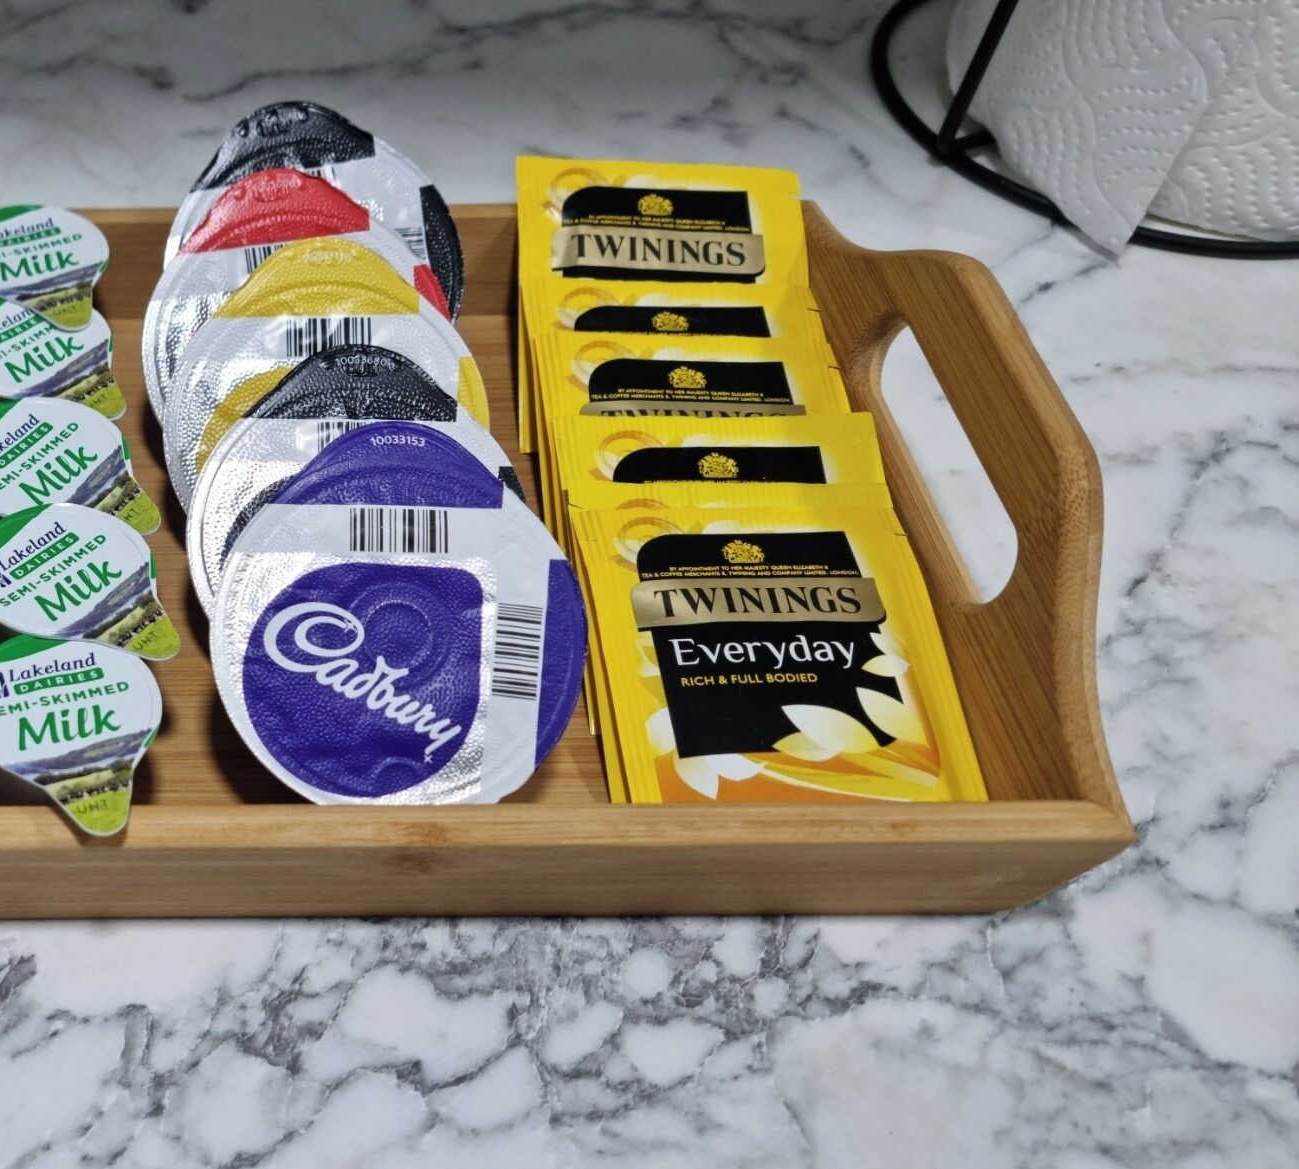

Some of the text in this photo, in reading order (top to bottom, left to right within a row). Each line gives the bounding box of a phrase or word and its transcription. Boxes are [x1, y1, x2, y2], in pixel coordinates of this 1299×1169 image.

[0, 250, 79, 282] Milk
[571, 233, 747, 267] TWININGS
[4, 336, 85, 384] Milk
[0, 424, 51, 468] DAIRIES
[370, 434, 426, 447] 10033153
[18, 446, 99, 506] Milk
[15, 536, 76, 578] DAIRIES
[33, 560, 123, 622] Milk
[653, 586, 861, 619] TWININGS
[8, 651, 99, 683] Lakeland
[667, 634, 855, 670] Everyday
[18, 669, 100, 693] DAIRIES
[263, 602, 462, 756] Cadbury
[680, 671, 818, 687] RICH & FULL BODIED
[18, 704, 122, 752] Milk
[76, 799, 110, 816] UHT
